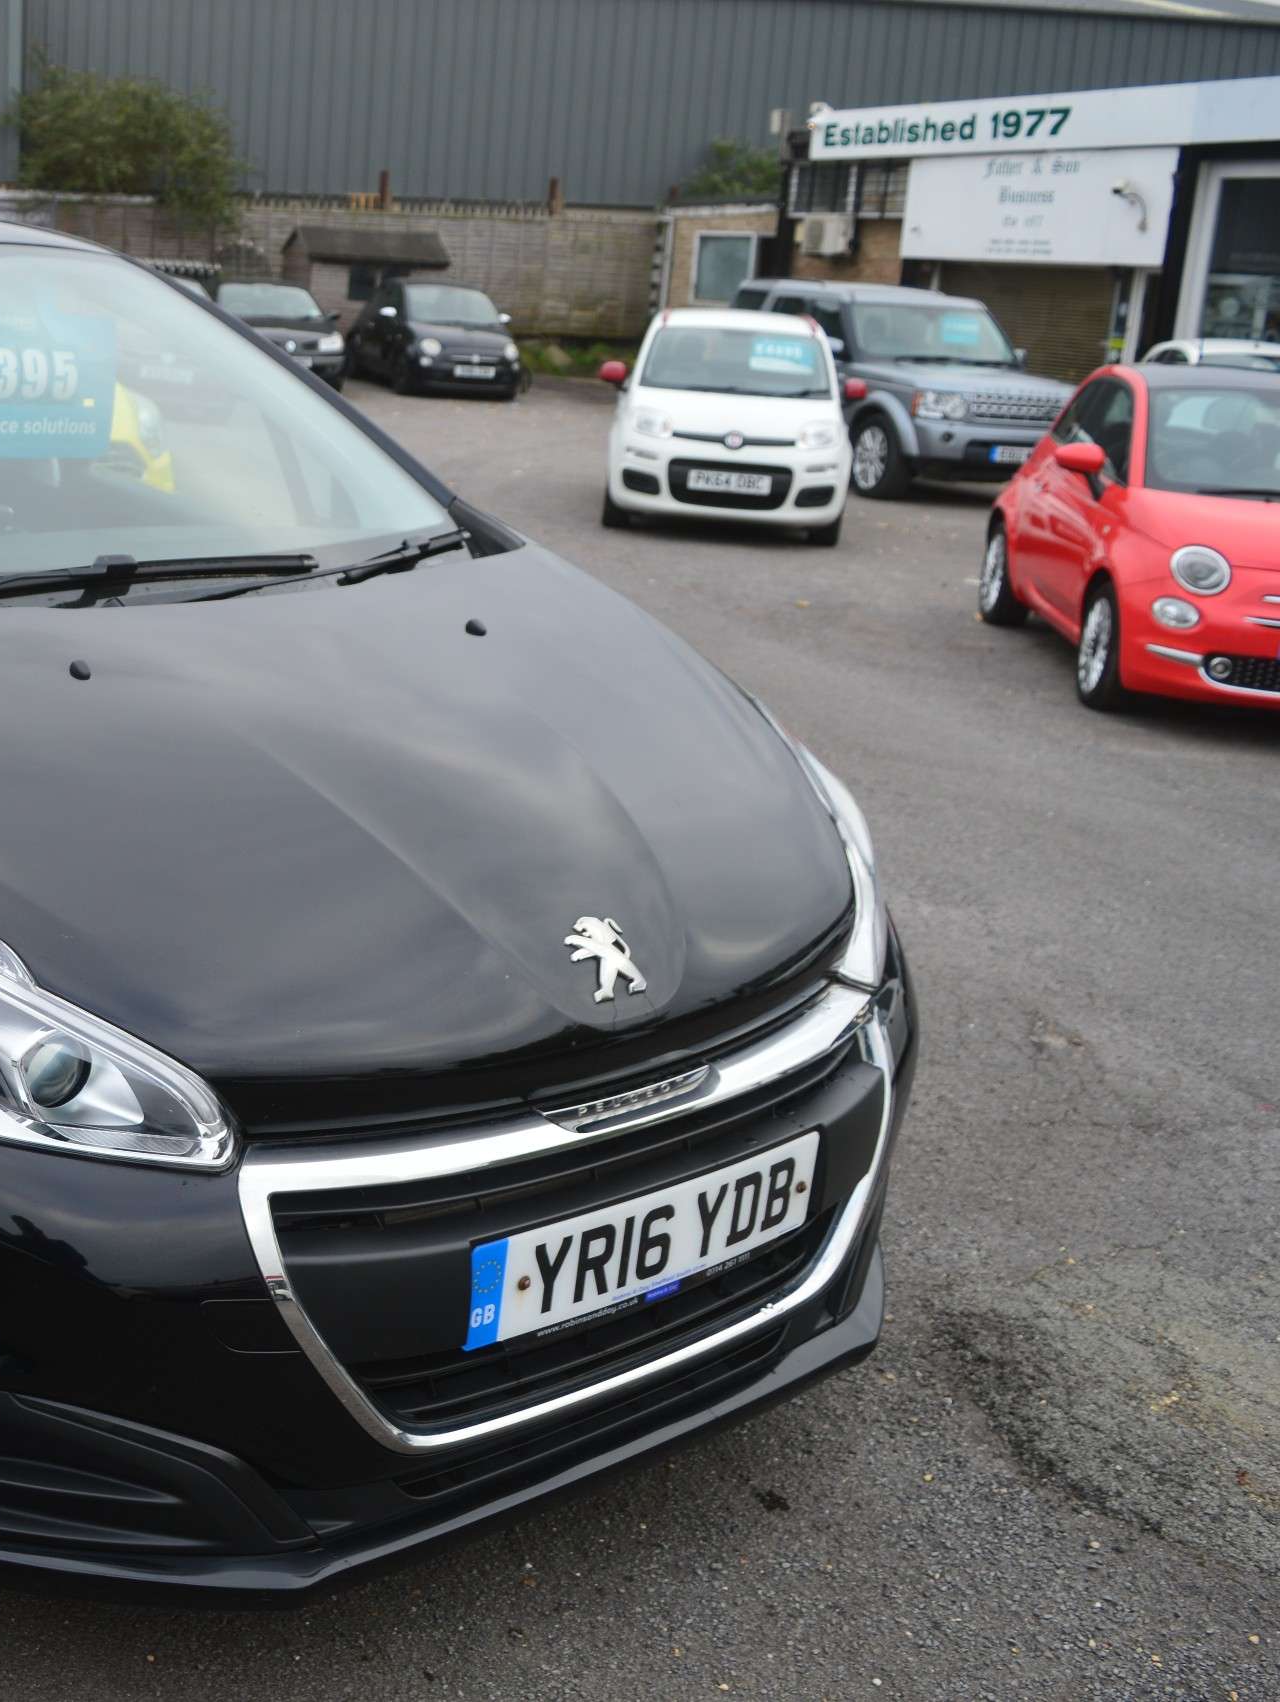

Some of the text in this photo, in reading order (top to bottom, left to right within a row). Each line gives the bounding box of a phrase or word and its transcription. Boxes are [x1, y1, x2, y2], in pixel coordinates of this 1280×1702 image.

[823, 107, 1073, 147] Established 1977
[23, 418, 97, 435] solutions
[535, 1156, 796, 1315] YR16 YDB
[471, 1303, 496, 1328] GB
